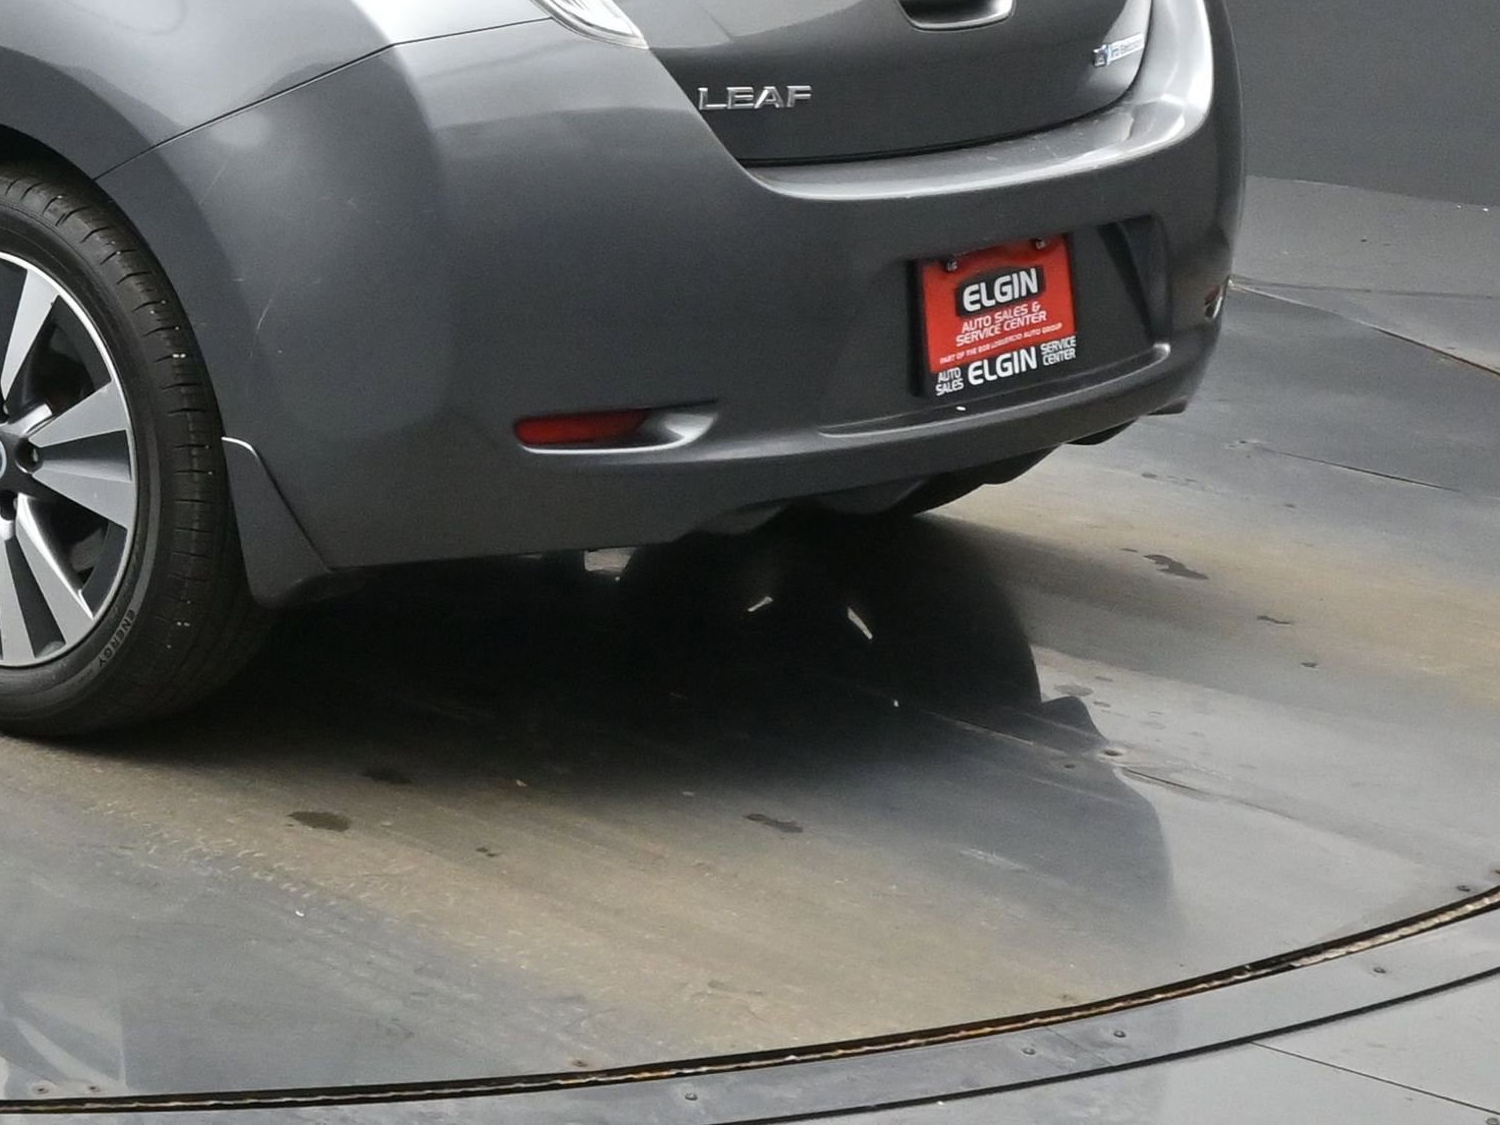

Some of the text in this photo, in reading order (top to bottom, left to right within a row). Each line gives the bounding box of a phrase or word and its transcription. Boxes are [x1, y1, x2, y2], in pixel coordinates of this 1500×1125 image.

[697, 84, 814, 111] LEAF
[963, 268, 1038, 311] ELGIN
[956, 310, 1047, 347] SERVICE CENTER
[961, 301, 1041, 333] AUTO SALES &
[968, 347, 1037, 385] ELGIN
[1040, 335, 1077, 366] SERVICE CENTER
[936, 367, 964, 395] AUTO SALES
[98, 609, 136, 668] ENERGY
